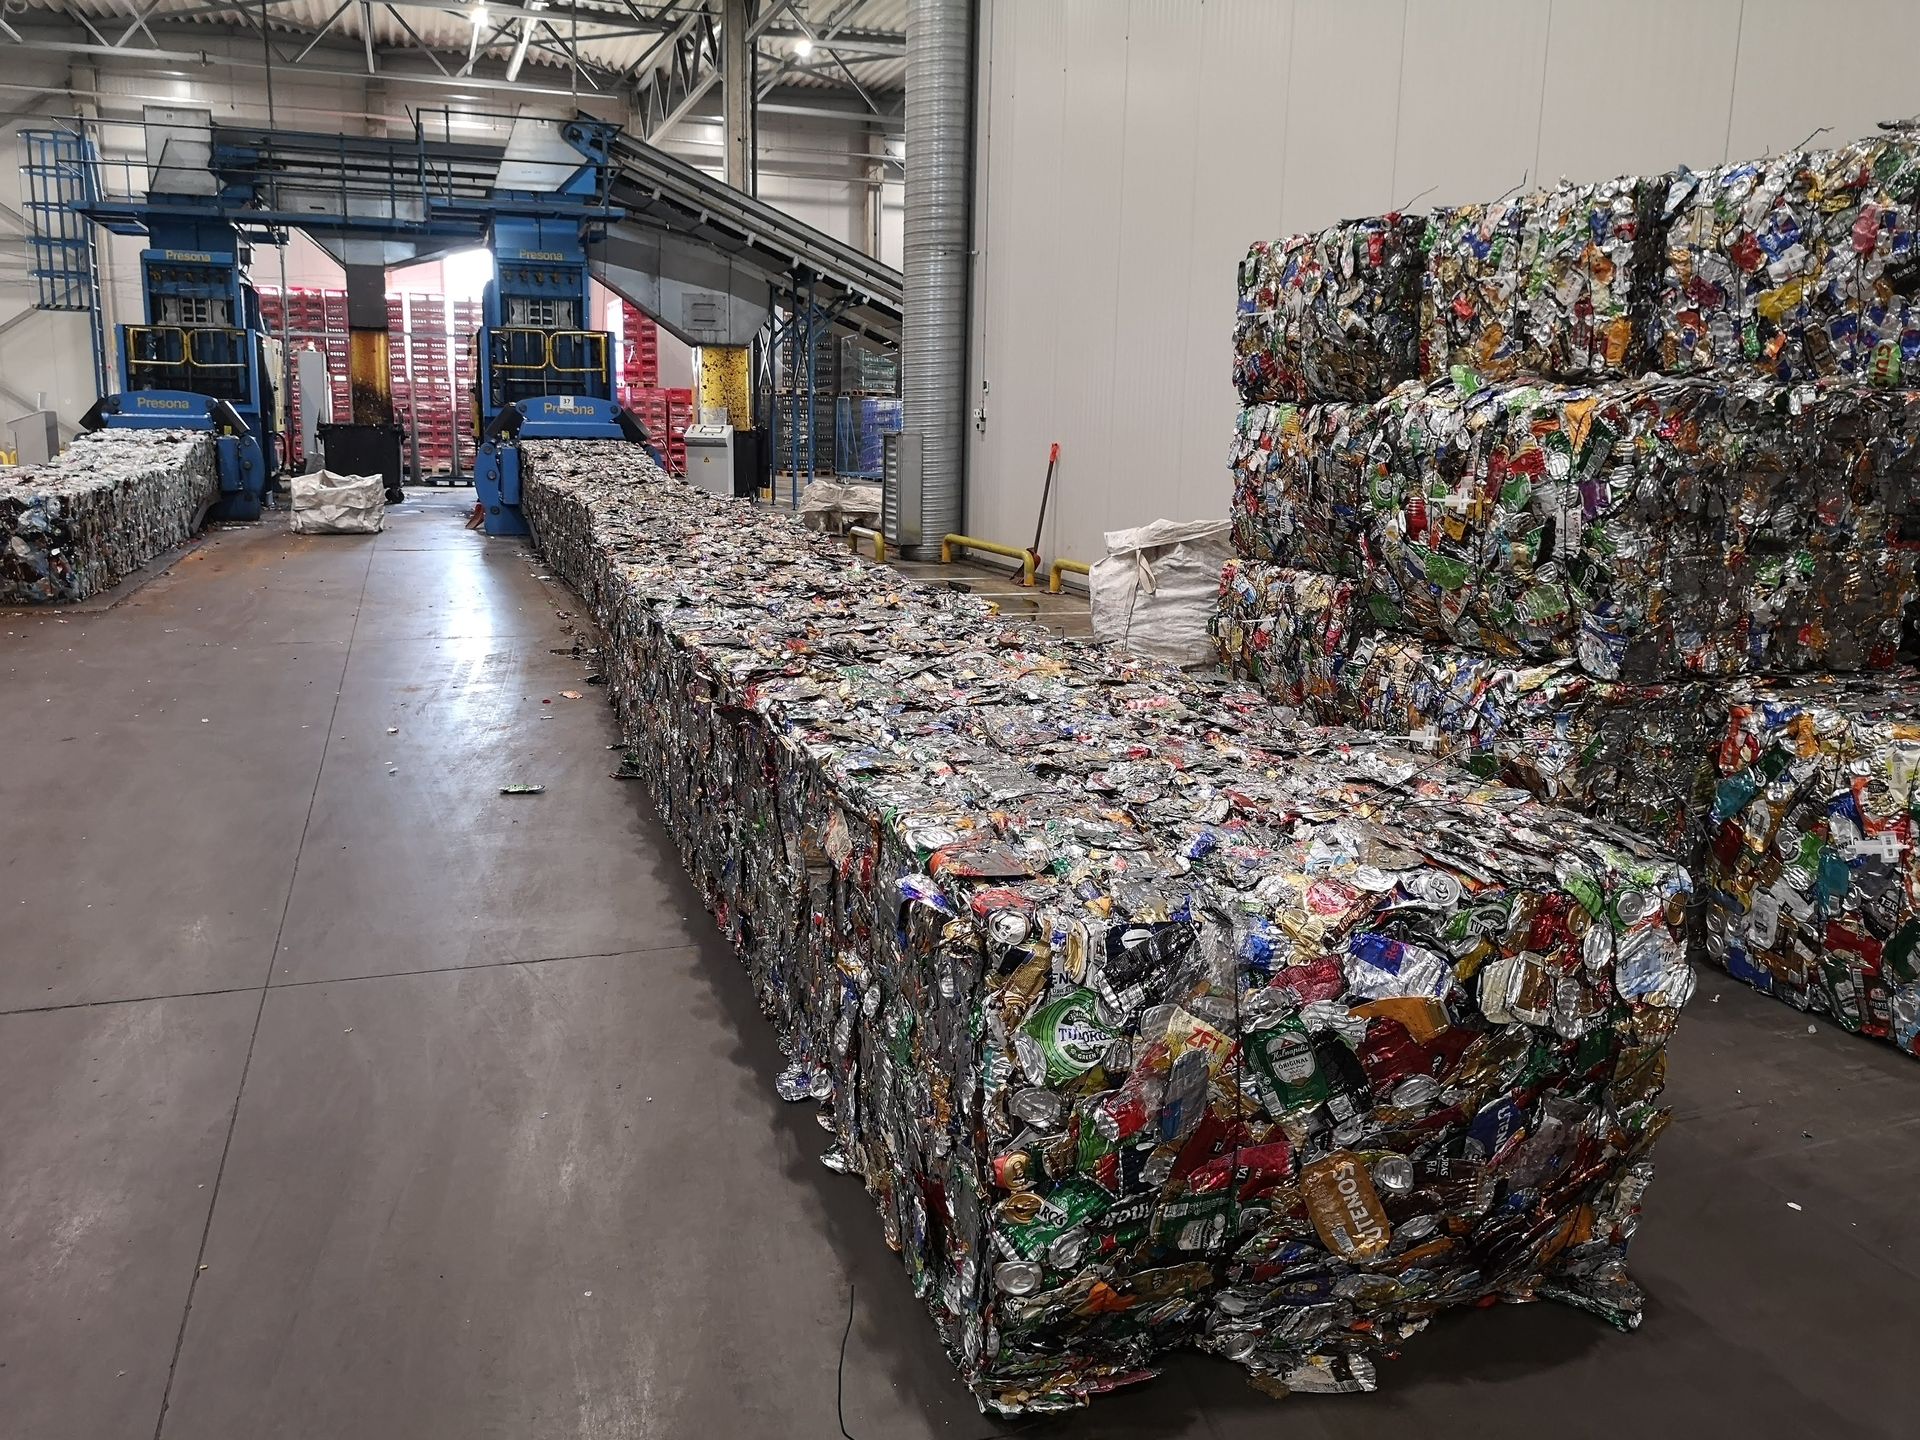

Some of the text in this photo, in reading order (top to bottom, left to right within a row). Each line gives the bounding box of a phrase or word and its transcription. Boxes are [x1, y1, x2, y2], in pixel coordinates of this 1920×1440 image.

[165, 249, 211, 262] Presona
[519, 249, 563, 261] Presona
[137, 397, 189, 409] Presona
[544, 402, 594, 415] Preona
[1278, 1057, 1309, 1070] ORIGINAL
